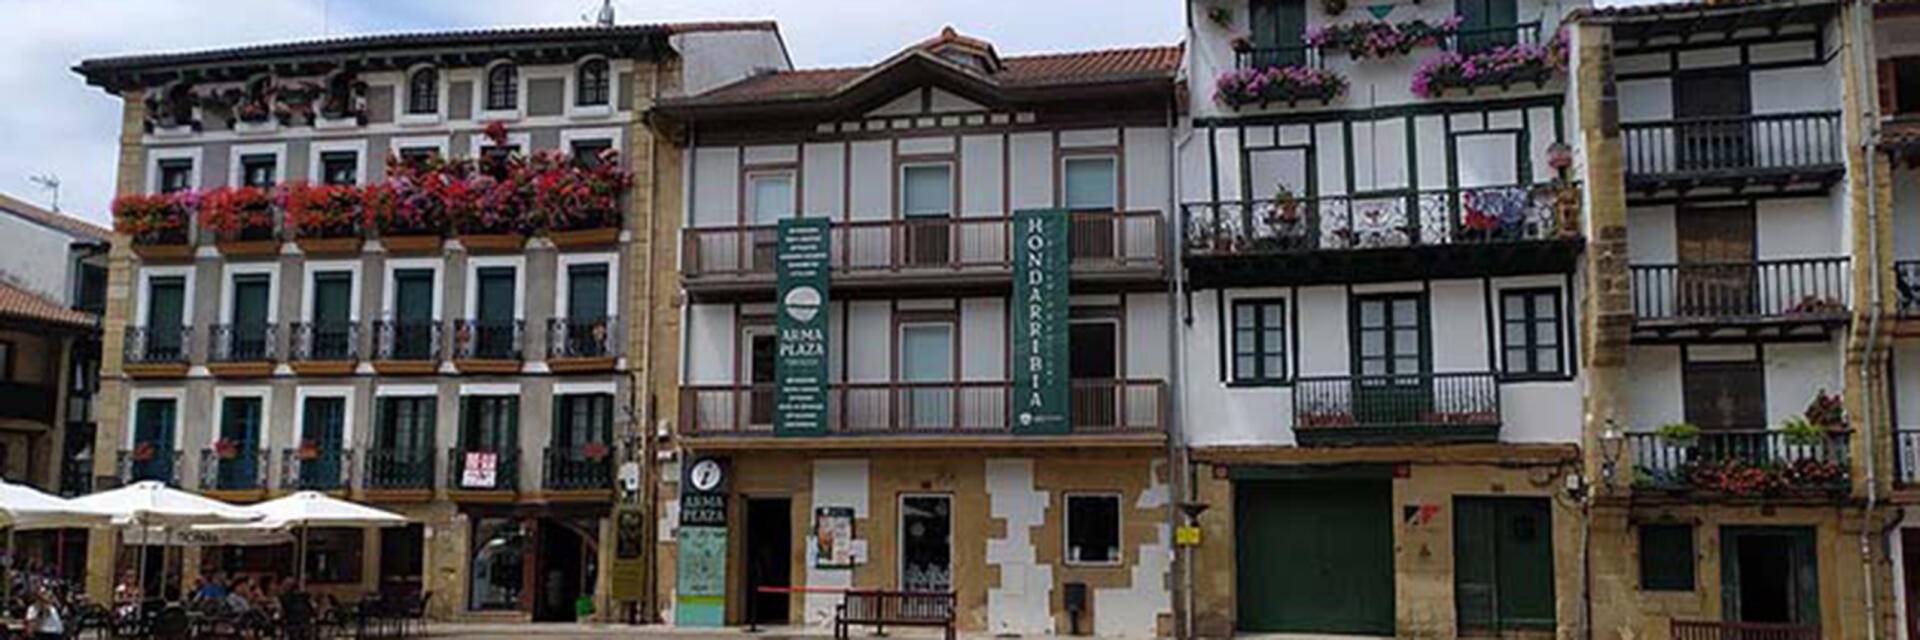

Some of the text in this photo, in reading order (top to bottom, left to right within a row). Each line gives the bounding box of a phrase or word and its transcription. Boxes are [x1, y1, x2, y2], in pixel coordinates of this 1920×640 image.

[1028, 217, 1044, 407] HONDARRIBIA
[781, 329, 823, 341] ARMA
[780, 343, 824, 356] PLAZA
[684, 496, 725, 509] ARMA
[683, 510, 725, 523] PLAZA
